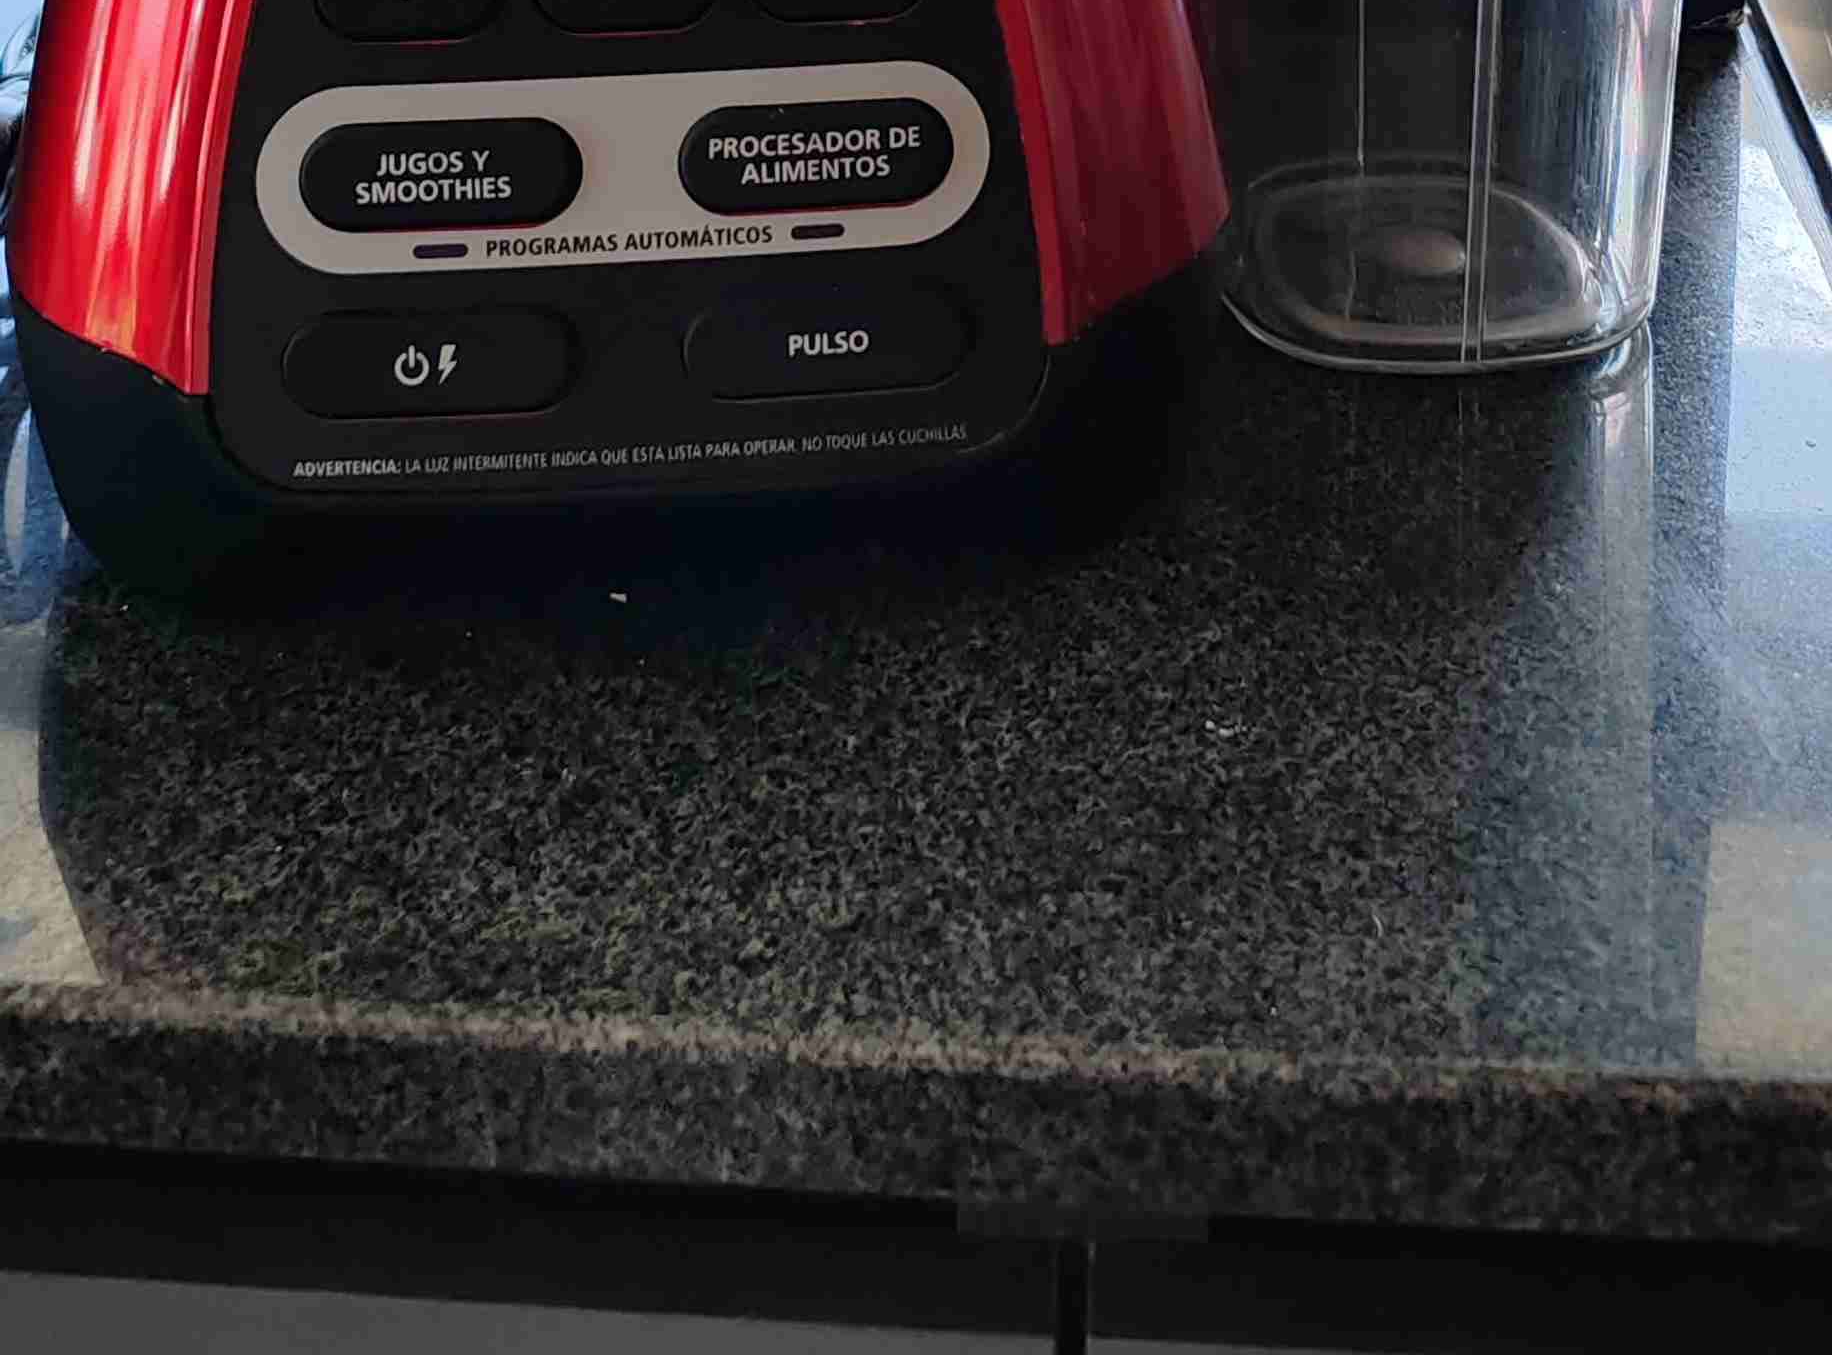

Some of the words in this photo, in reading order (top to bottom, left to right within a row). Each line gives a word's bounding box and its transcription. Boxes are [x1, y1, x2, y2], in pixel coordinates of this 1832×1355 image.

[708, 128, 882, 159] PROCESADOR
[889, 126, 921, 149] DE
[376, 151, 464, 177] JUGOS
[471, 150, 490, 172] Y
[741, 155, 891, 185] ALIMENTOS
[355, 175, 512, 205] SMOOTHIES
[484, 230, 619, 257] PROGRAMAS
[624, 224, 774, 253] AUTOMÁTICOS
[788, 330, 869, 357] PULSO
[293, 458, 402, 478] ADVERTENCIA:
[405, 457, 422, 474] LA
[424, 456, 450, 473] LUZ
[551, 449, 598, 467] INDICA
[600, 446, 628, 466] QUE
[667, 443, 703, 461] LISTA
[704, 440, 741, 458] PARA
[802, 435, 823, 452] NO
[824, 432, 868, 451] TOQUE
[871, 430, 896, 446] LAS
[898, 423, 967, 444] CUCHILLAS
